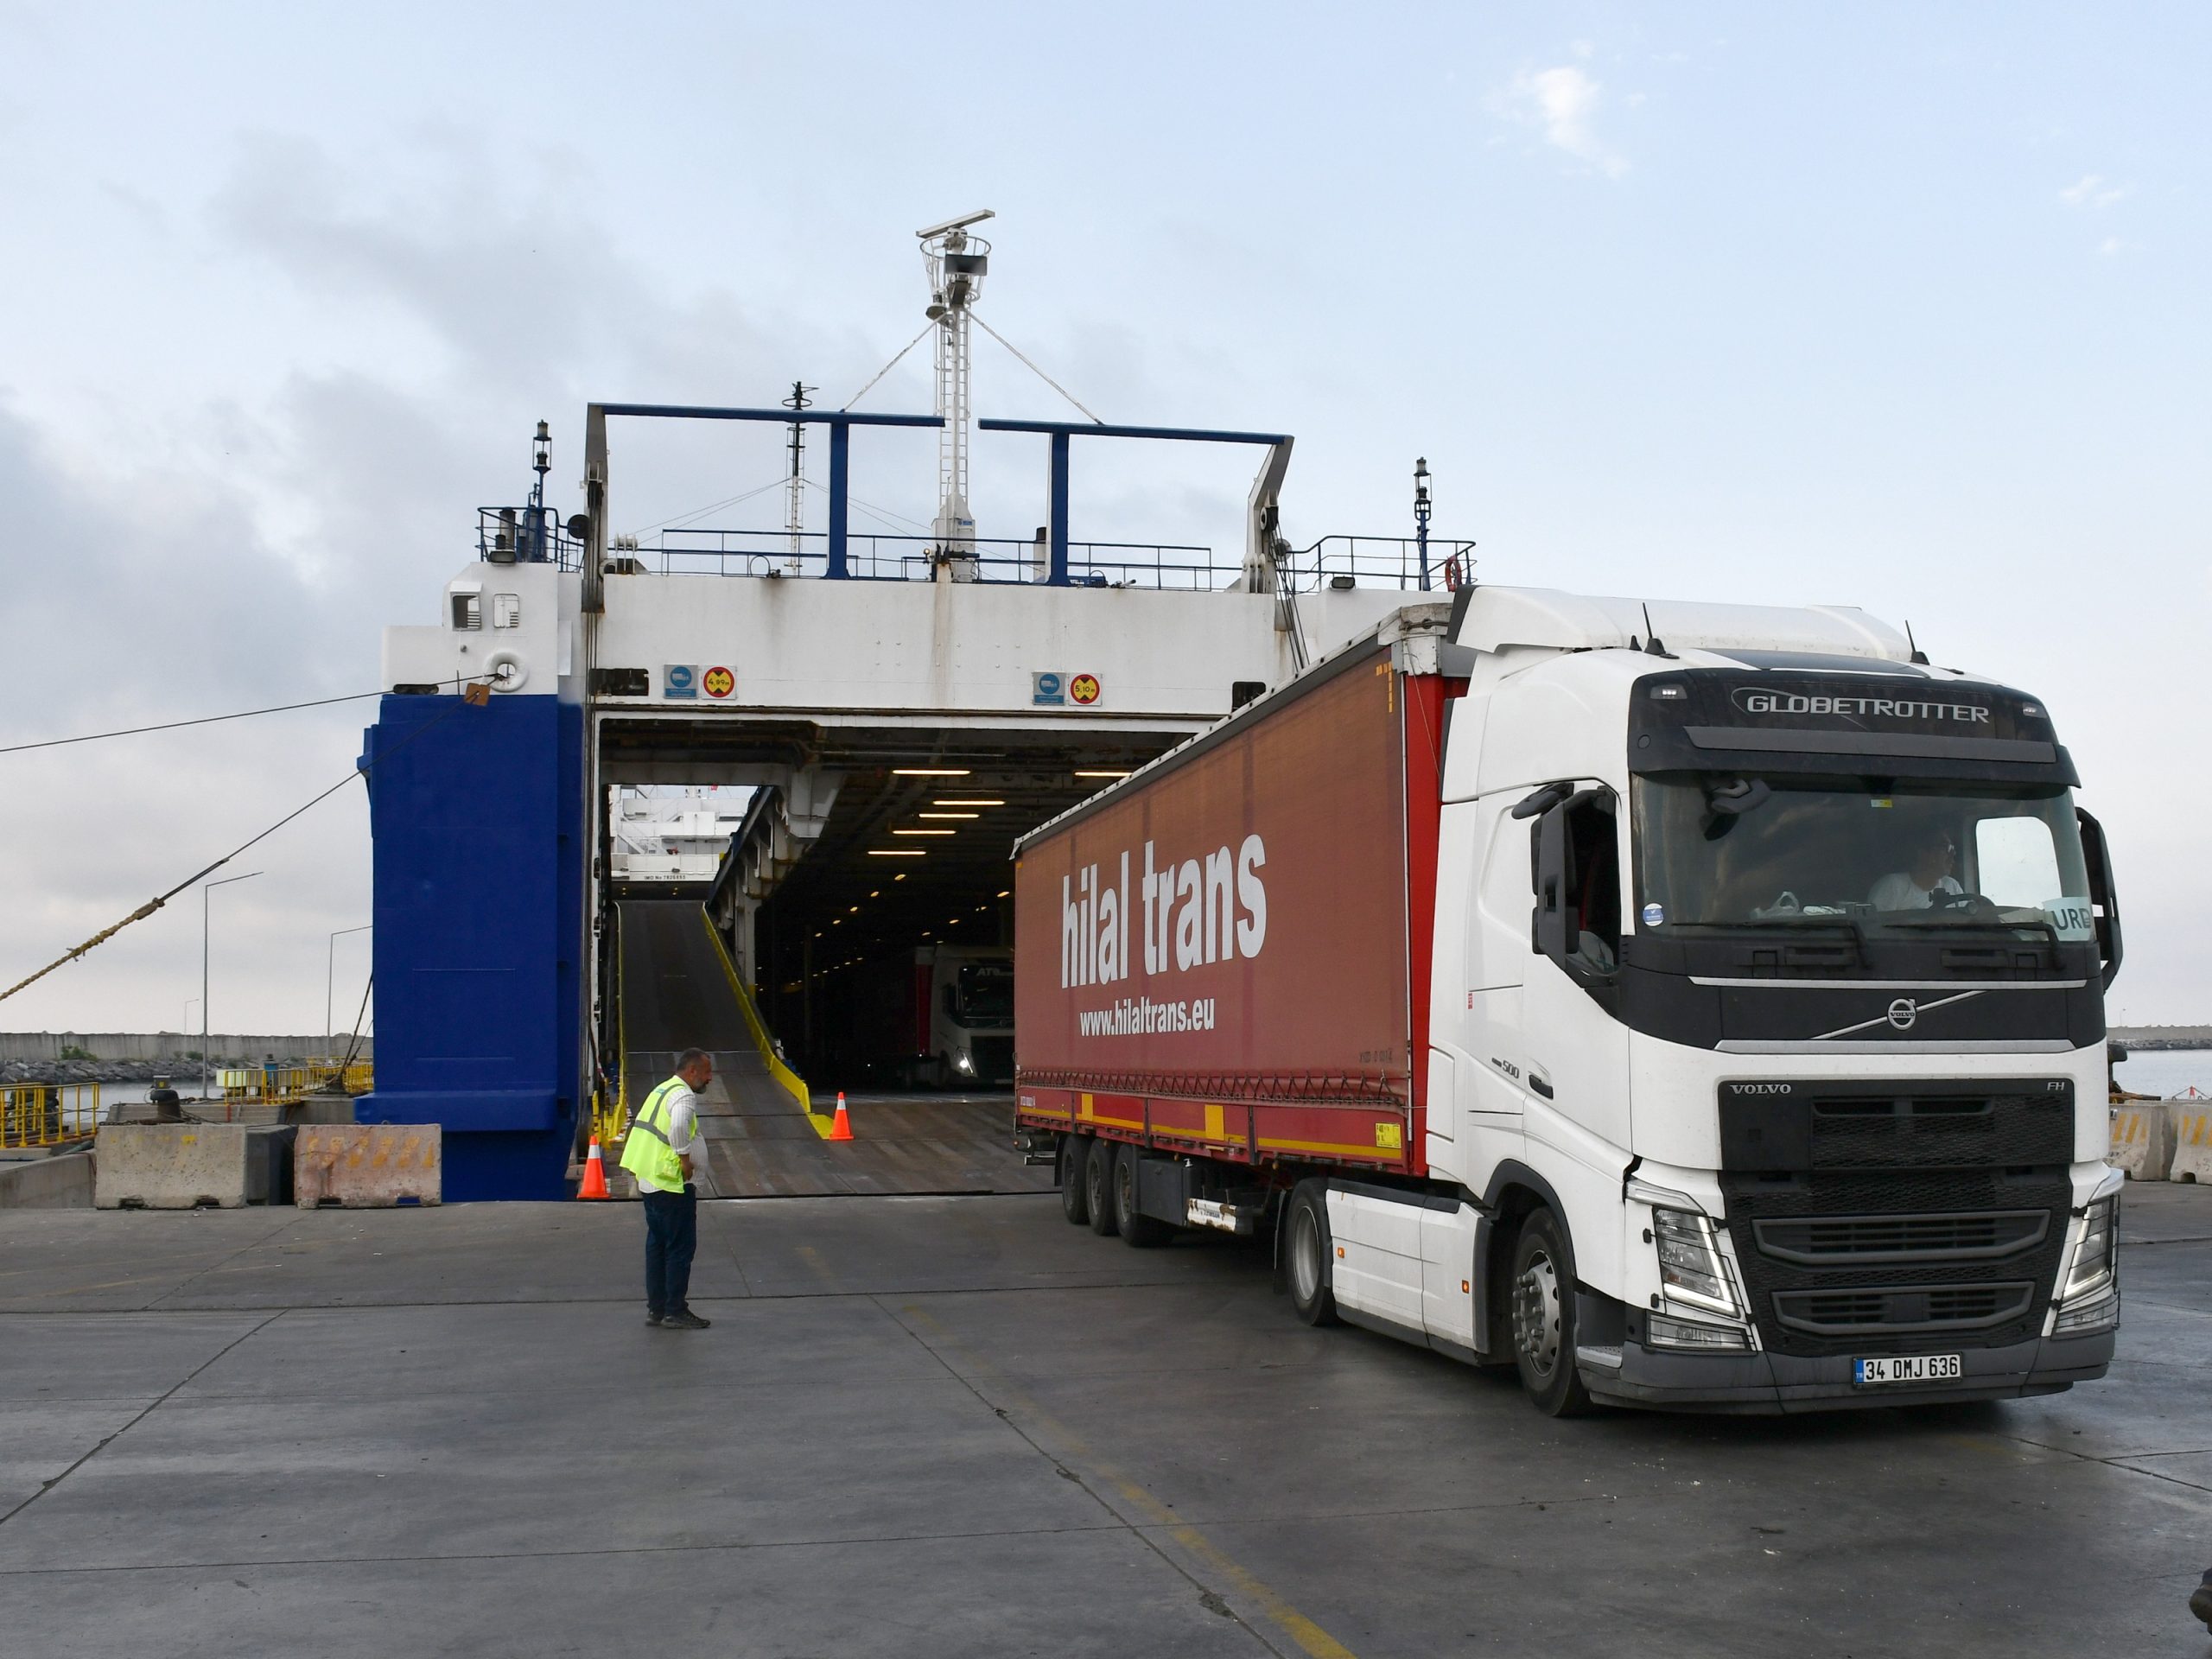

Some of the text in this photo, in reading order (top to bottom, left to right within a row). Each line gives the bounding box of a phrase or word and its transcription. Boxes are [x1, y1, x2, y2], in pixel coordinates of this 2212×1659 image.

[1747, 695, 1990, 723] GLOBETROTTER
[1061, 833, 1268, 989] hilal trans
[1079, 995, 1215, 1037] www.hilaltrans.eu
[1502, 1059, 1520, 1079] 500
[1729, 1084, 1792, 1095] VOLVO
[2047, 1081, 2065, 1091] FH
[1866, 1361, 1885, 1380] 34
[1893, 1358, 1923, 1379] DMJ
[1929, 1357, 1958, 1376] 636
